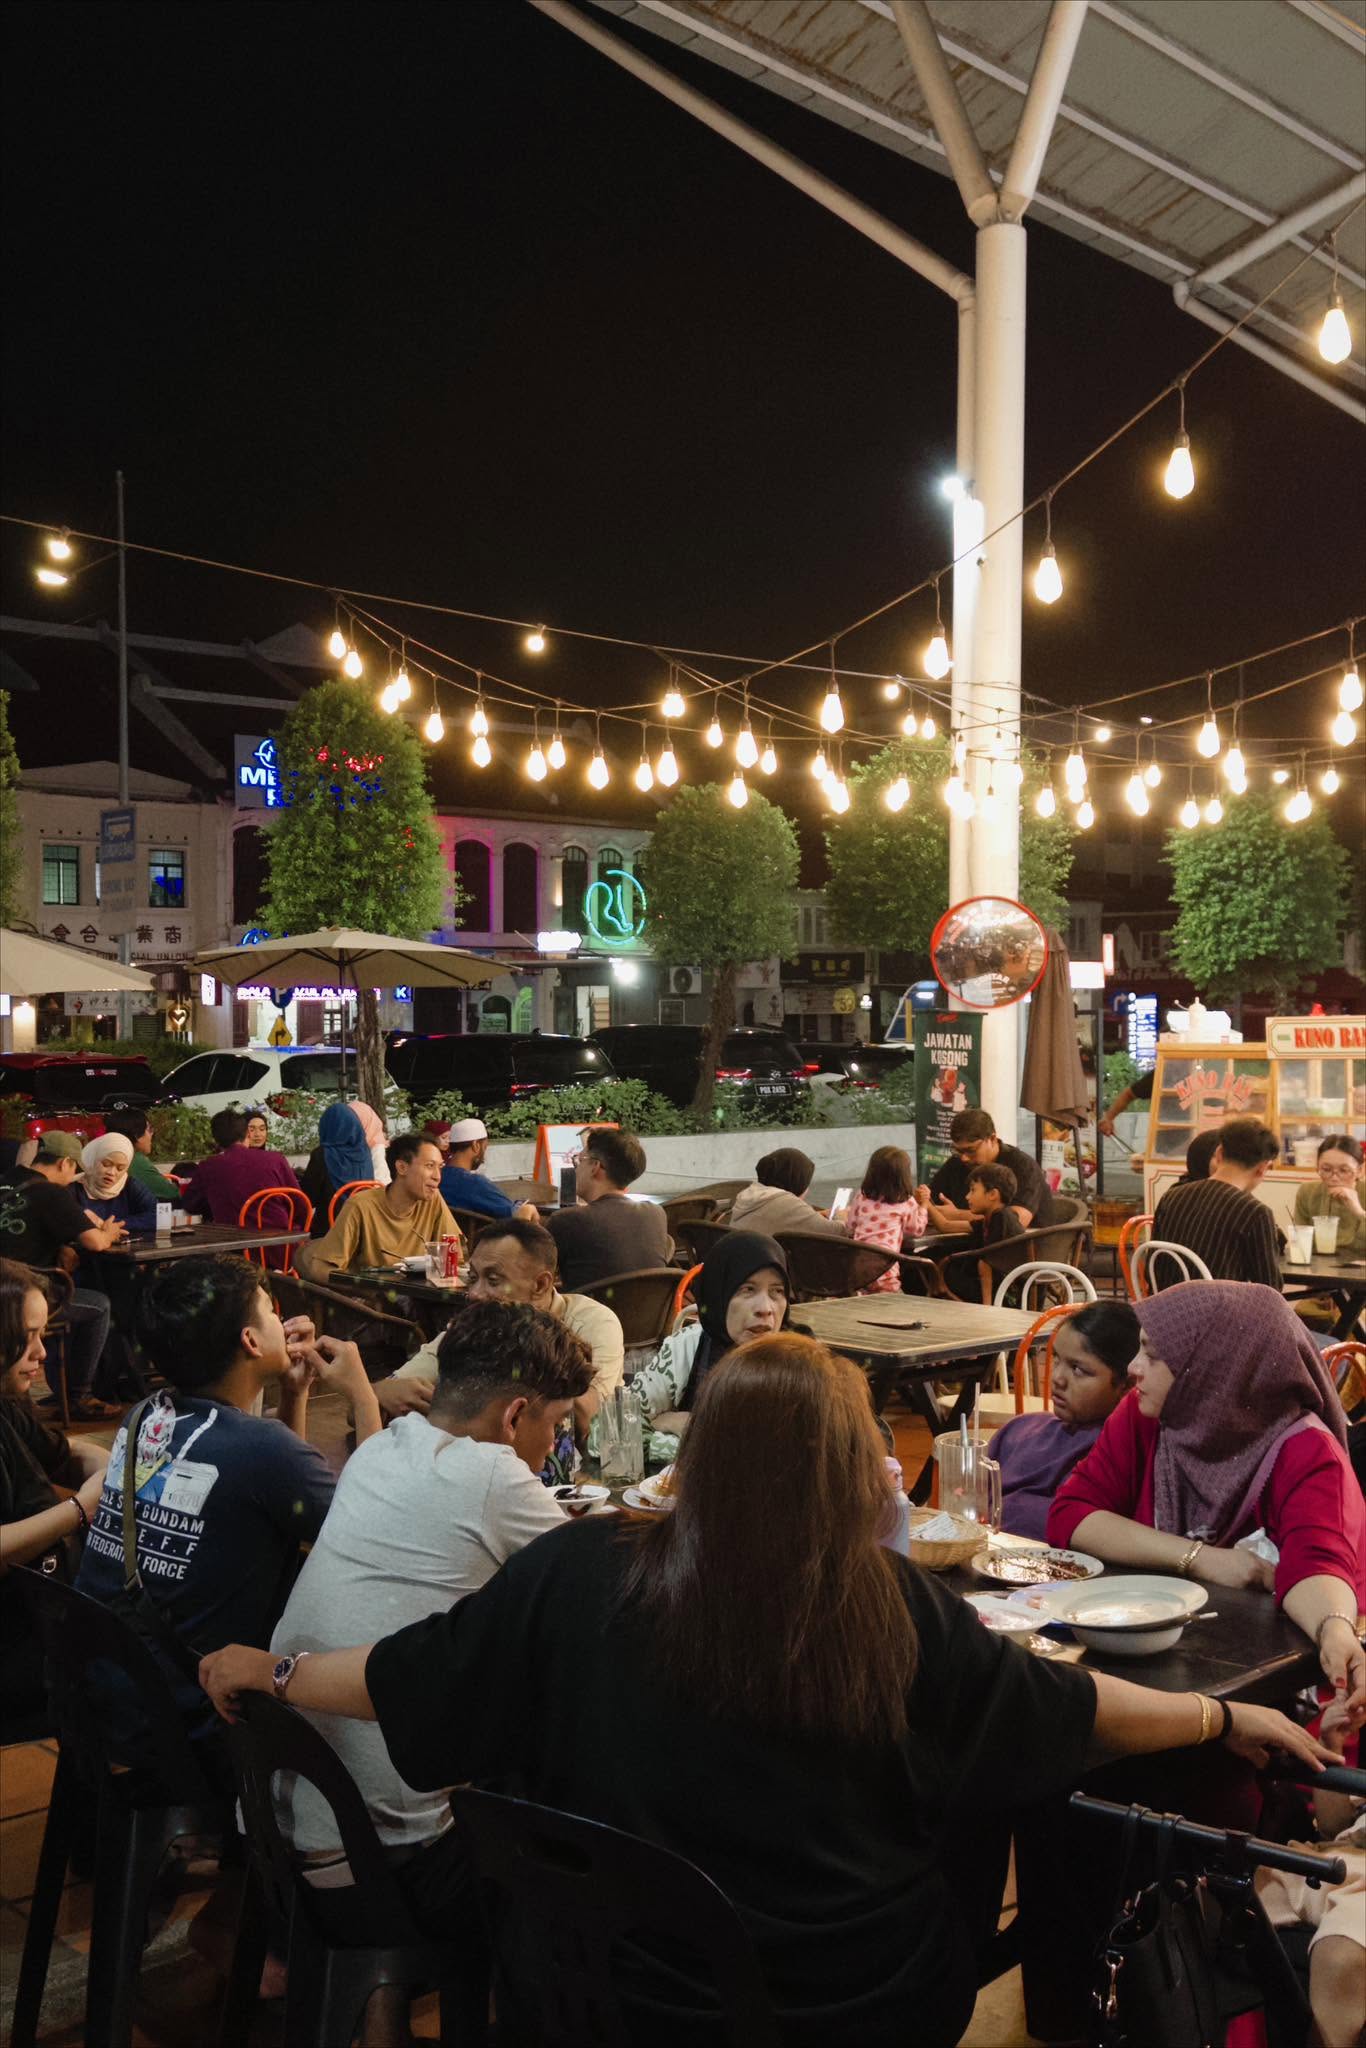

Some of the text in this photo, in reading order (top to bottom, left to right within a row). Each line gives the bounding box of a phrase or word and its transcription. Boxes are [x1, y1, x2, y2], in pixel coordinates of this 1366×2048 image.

[923, 1032, 972, 1050] JAWATAN
[1294, 1027, 1335, 1048] KUNO
[930, 1049, 968, 1066] KOSONG
[142, 1502, 205, 1534] GUNDAM
[142, 1555, 187, 1580] FORCE
